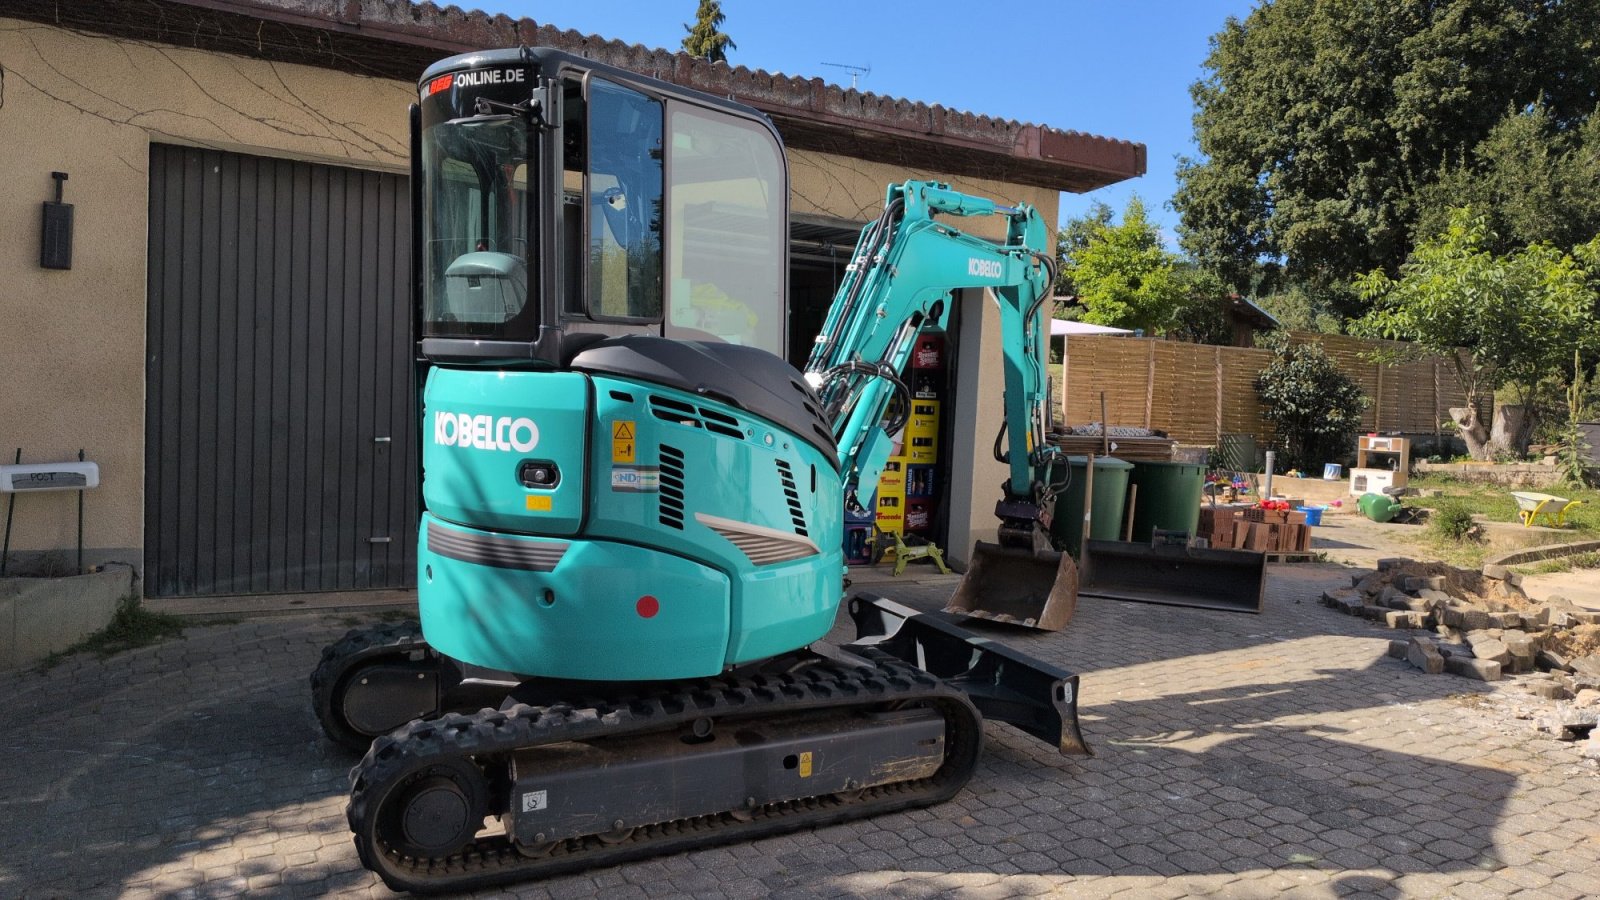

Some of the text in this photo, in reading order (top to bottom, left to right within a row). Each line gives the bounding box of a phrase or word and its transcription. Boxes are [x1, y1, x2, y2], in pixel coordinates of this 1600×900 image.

[968, 257, 1002, 278] KOBELCO
[434, 411, 540, 453] KOBELCO
[30, 472, 57, 481] POST
